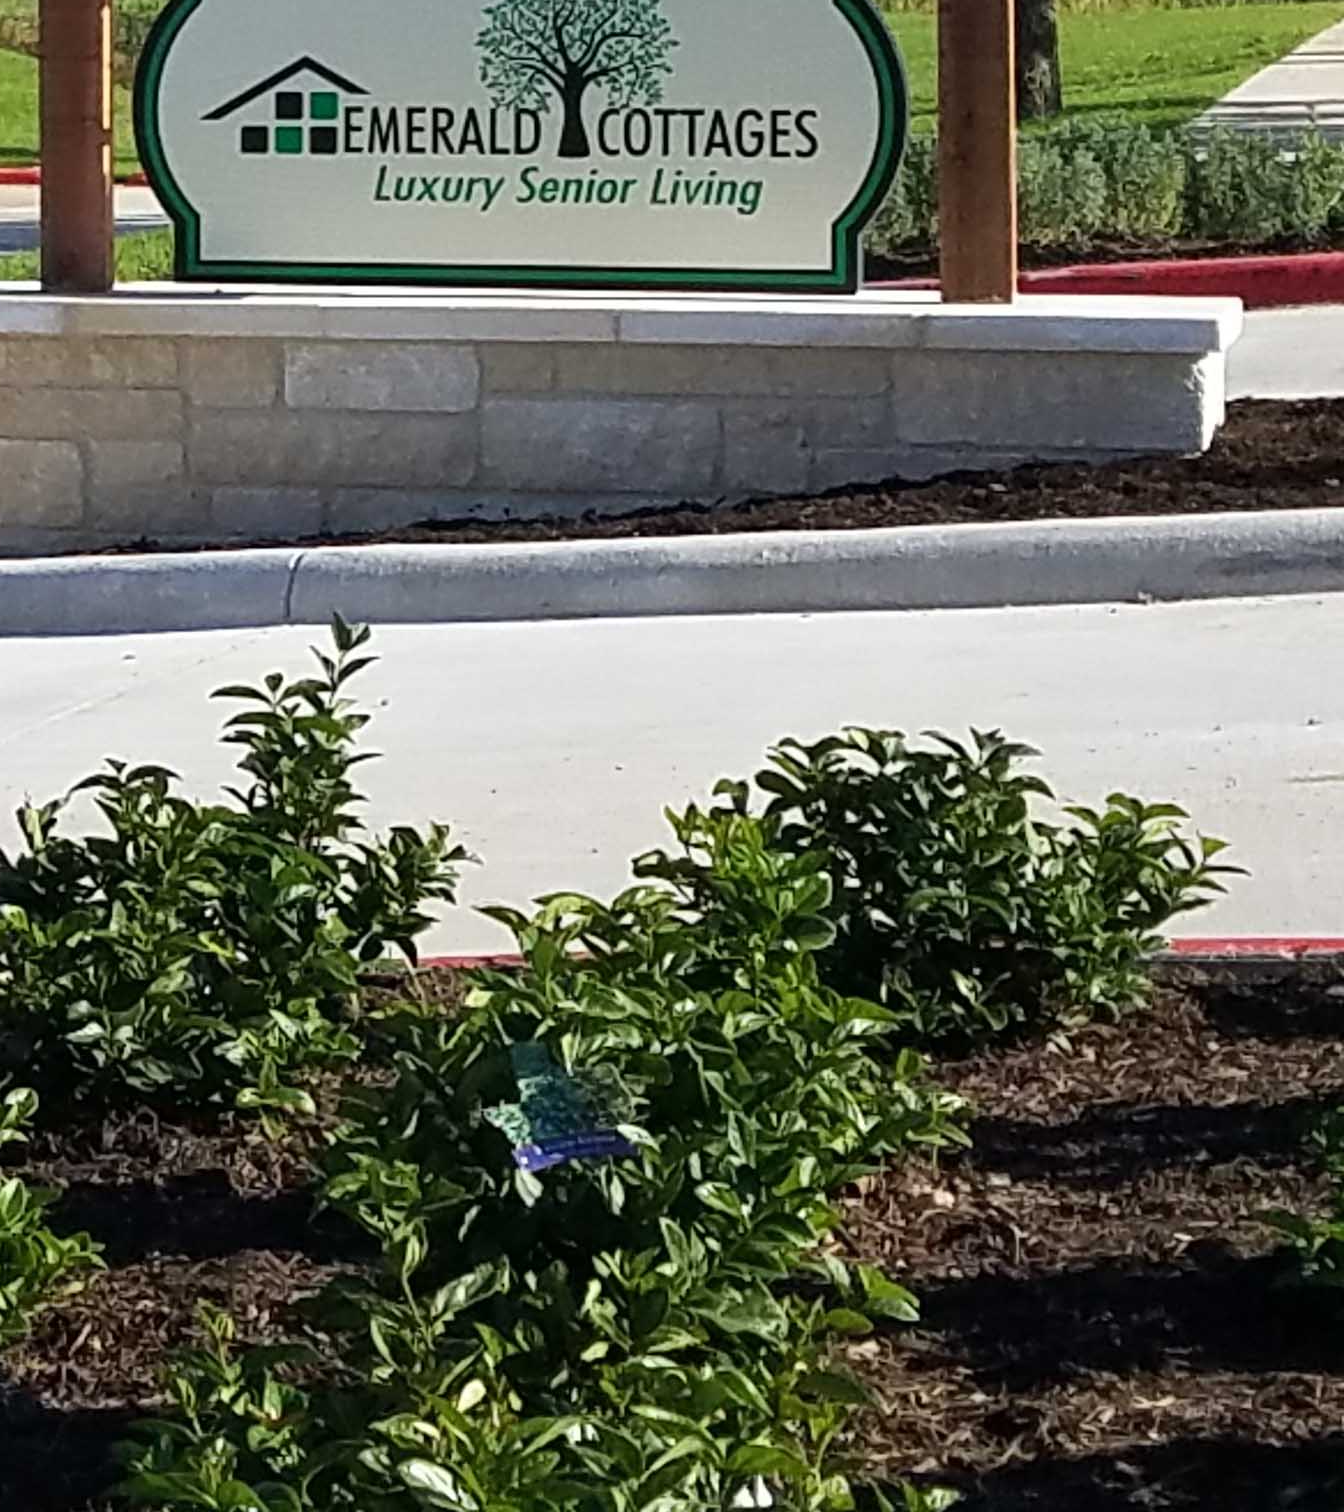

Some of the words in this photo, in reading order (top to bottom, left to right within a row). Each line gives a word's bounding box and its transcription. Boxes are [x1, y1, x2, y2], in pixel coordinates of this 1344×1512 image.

[344, 106, 541, 155] EMERALD
[598, 108, 819, 157] COTTAGES
[374, 164, 505, 212] Luxury
[516, 166, 637, 204] Senior
[650, 168, 763, 215] Living
